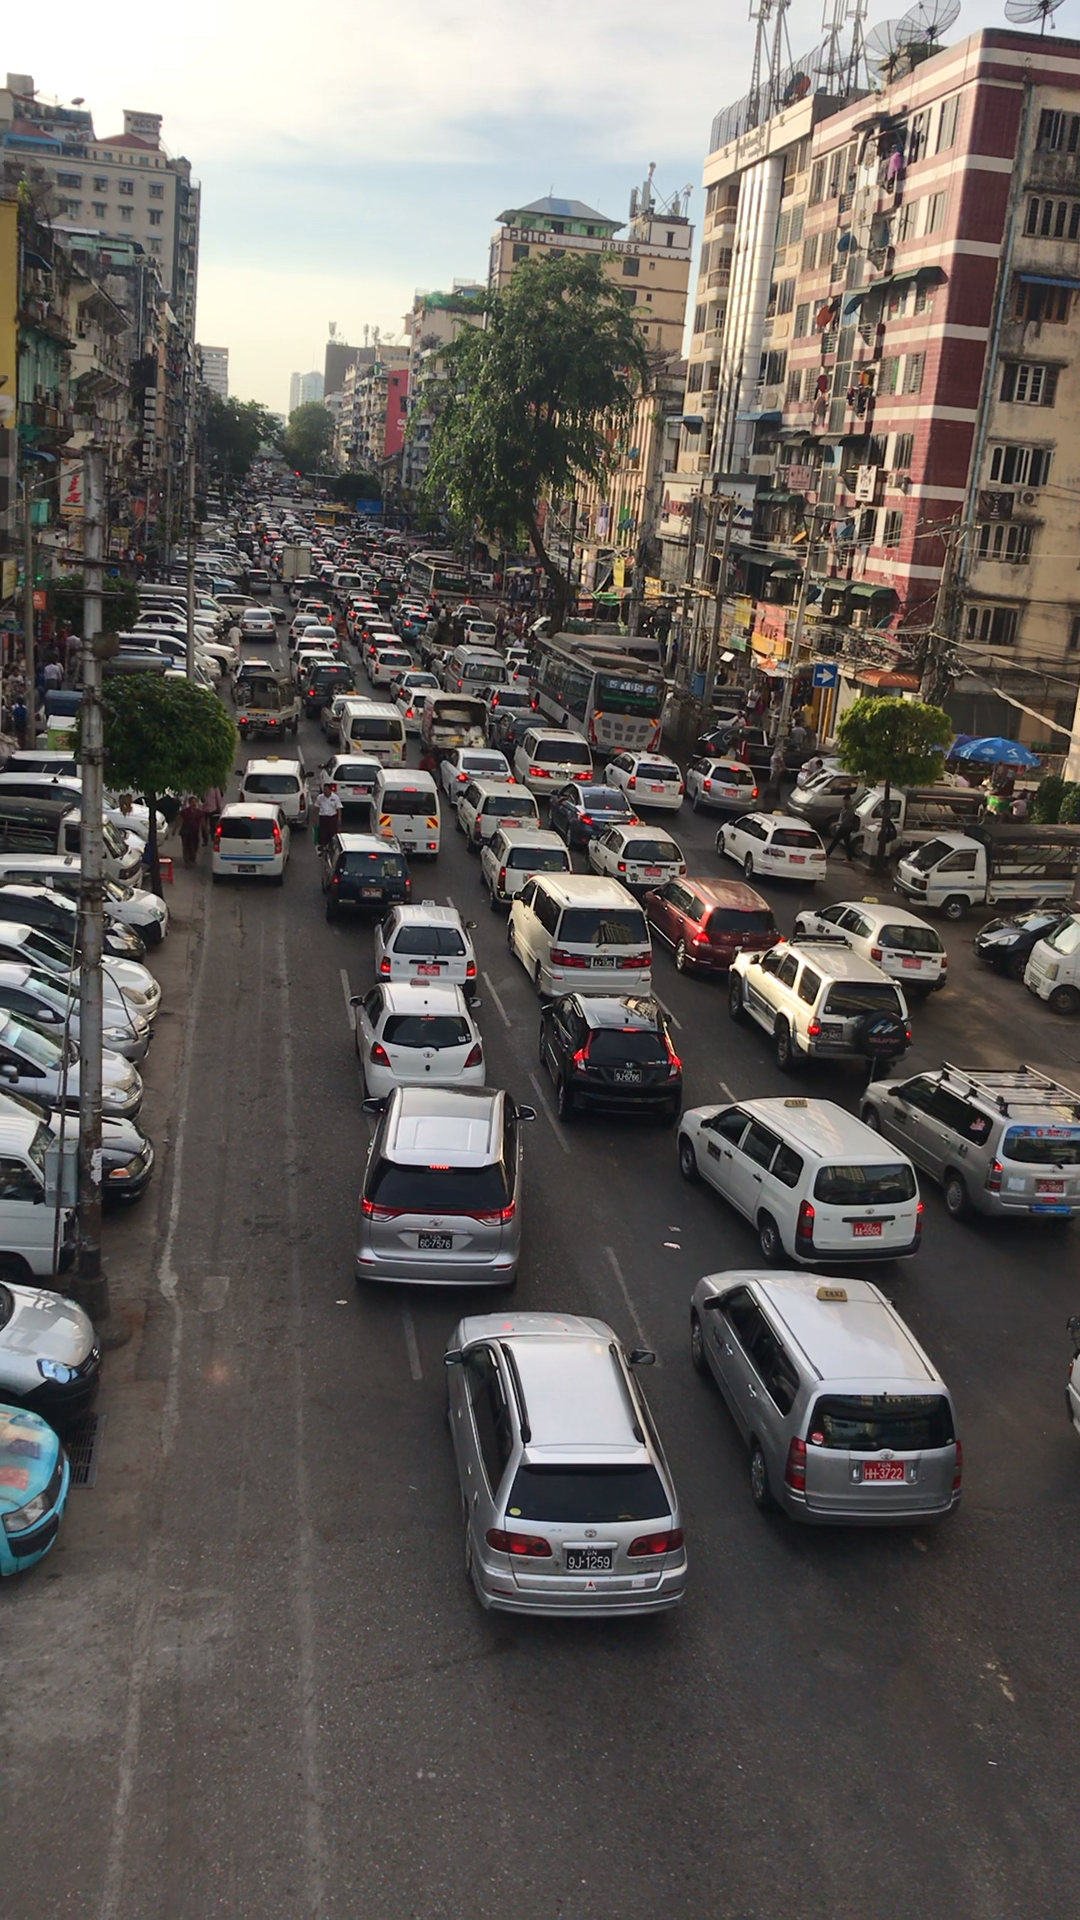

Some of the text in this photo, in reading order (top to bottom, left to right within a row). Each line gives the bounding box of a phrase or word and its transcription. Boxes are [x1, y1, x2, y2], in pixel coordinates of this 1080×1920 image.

[600, 241, 641, 255] HOUSE
[420, 1239, 451, 1249] 6C-7576
[823, 1290, 844, 1298] TAXI
[864, 1467, 903, 1480] HH-3722
[568, 1556, 611, 1569] 9J-1259
